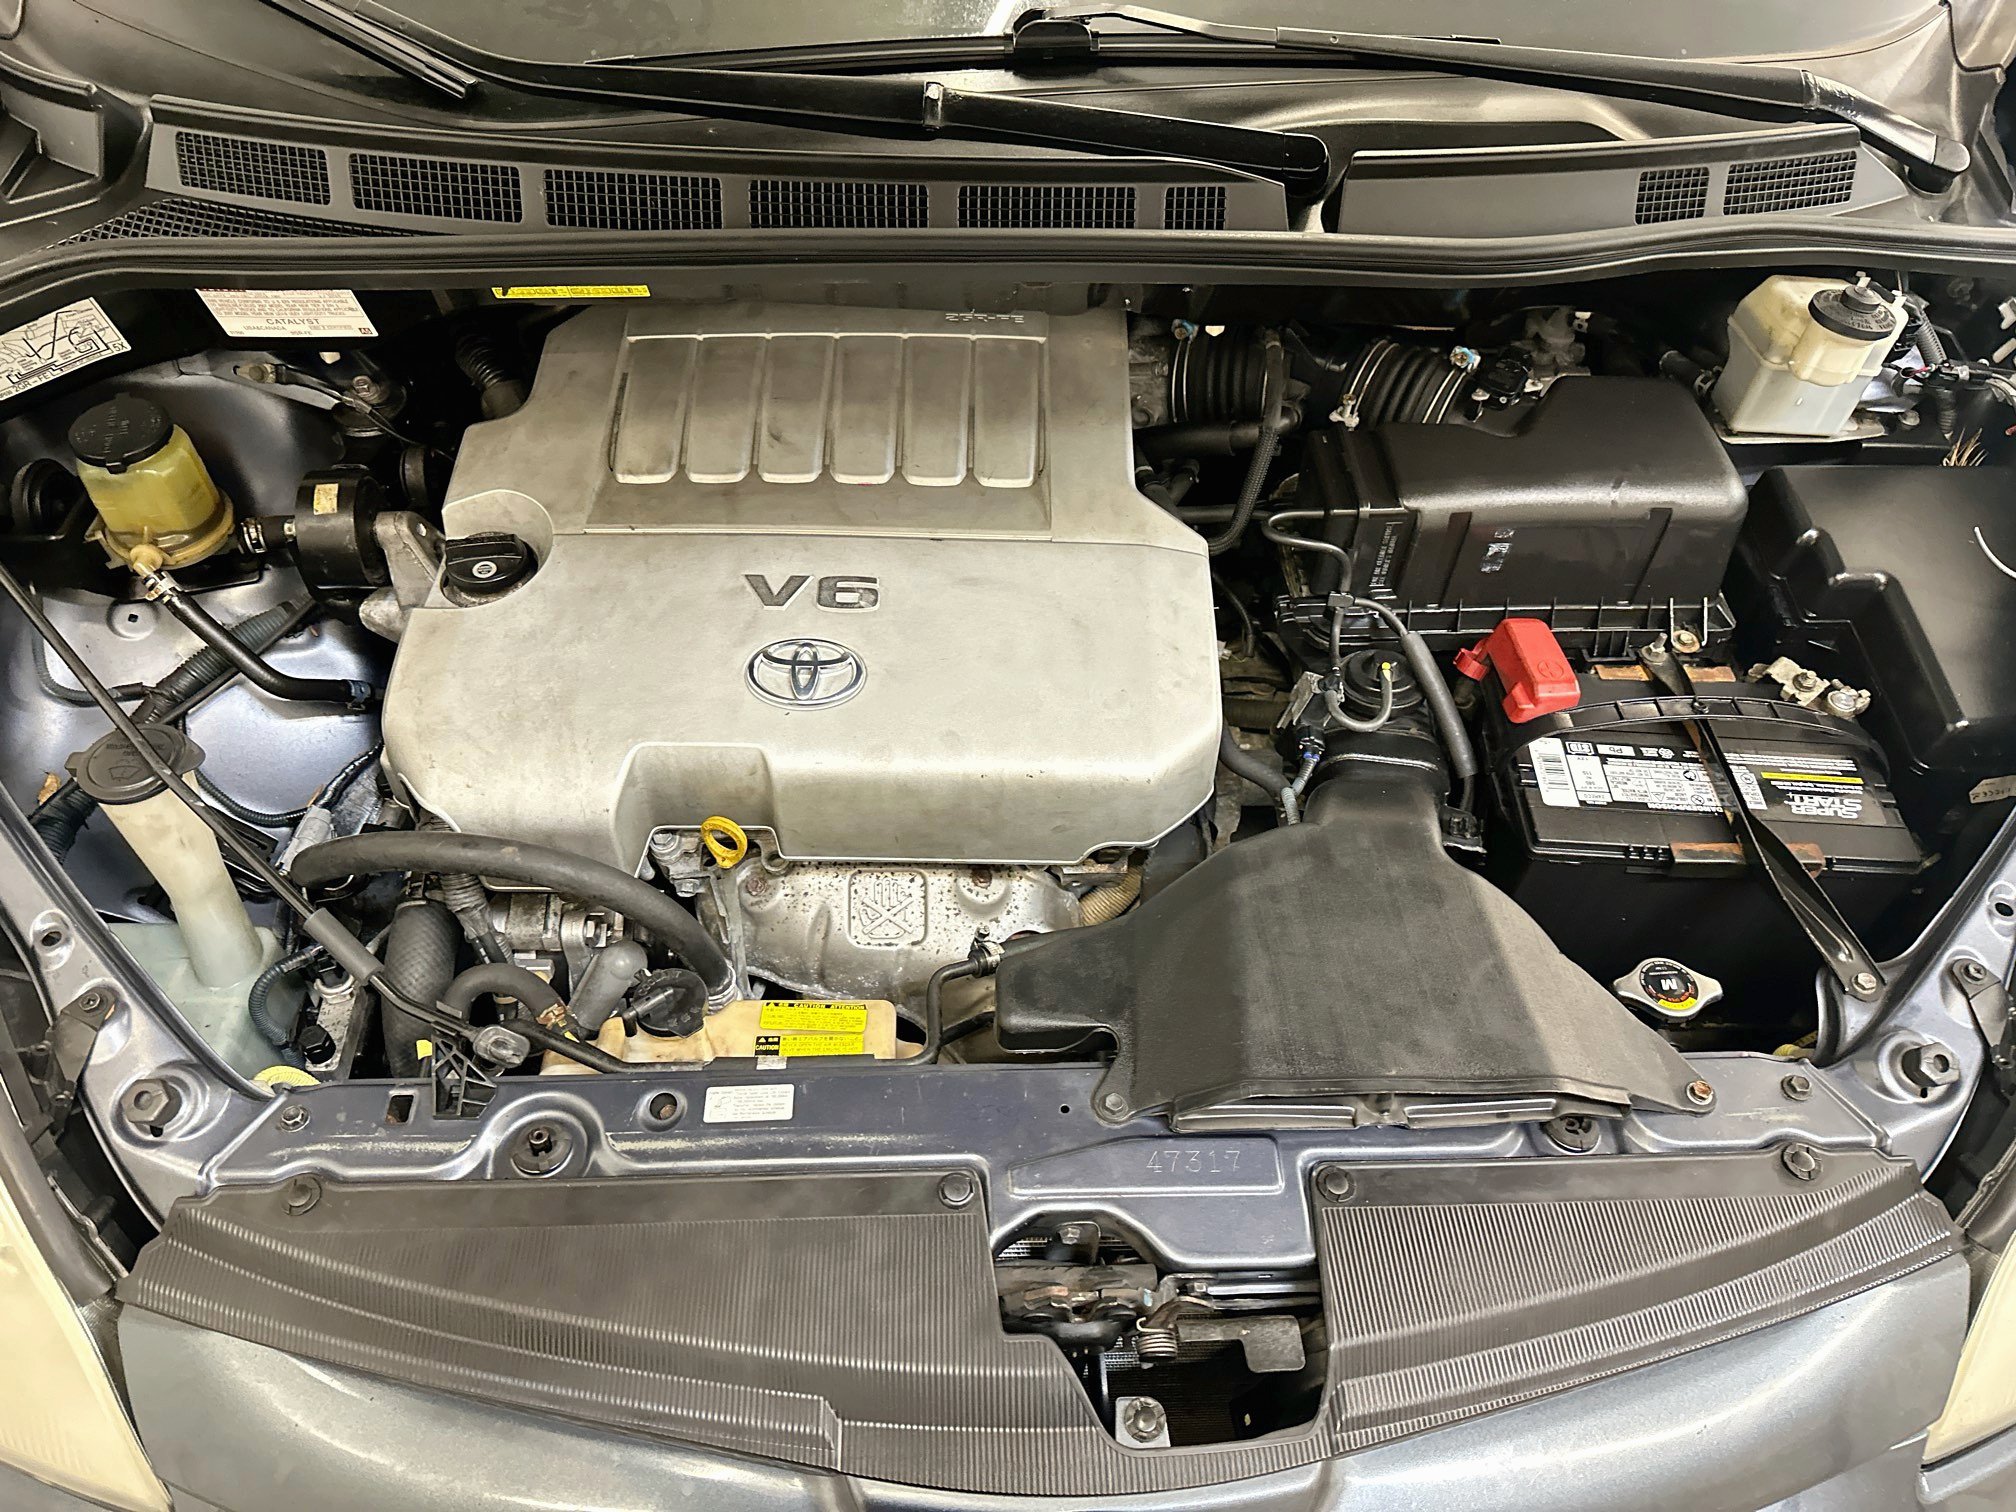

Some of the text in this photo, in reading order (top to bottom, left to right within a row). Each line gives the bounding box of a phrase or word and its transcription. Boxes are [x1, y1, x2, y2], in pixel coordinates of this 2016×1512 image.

[112, 342, 127, 352] 5X
[742, 574, 879, 612] V6
[1784, 796, 1863, 811] START
[1792, 804, 1858, 819] SUPER
[1145, 1150, 1241, 1173] 47317
